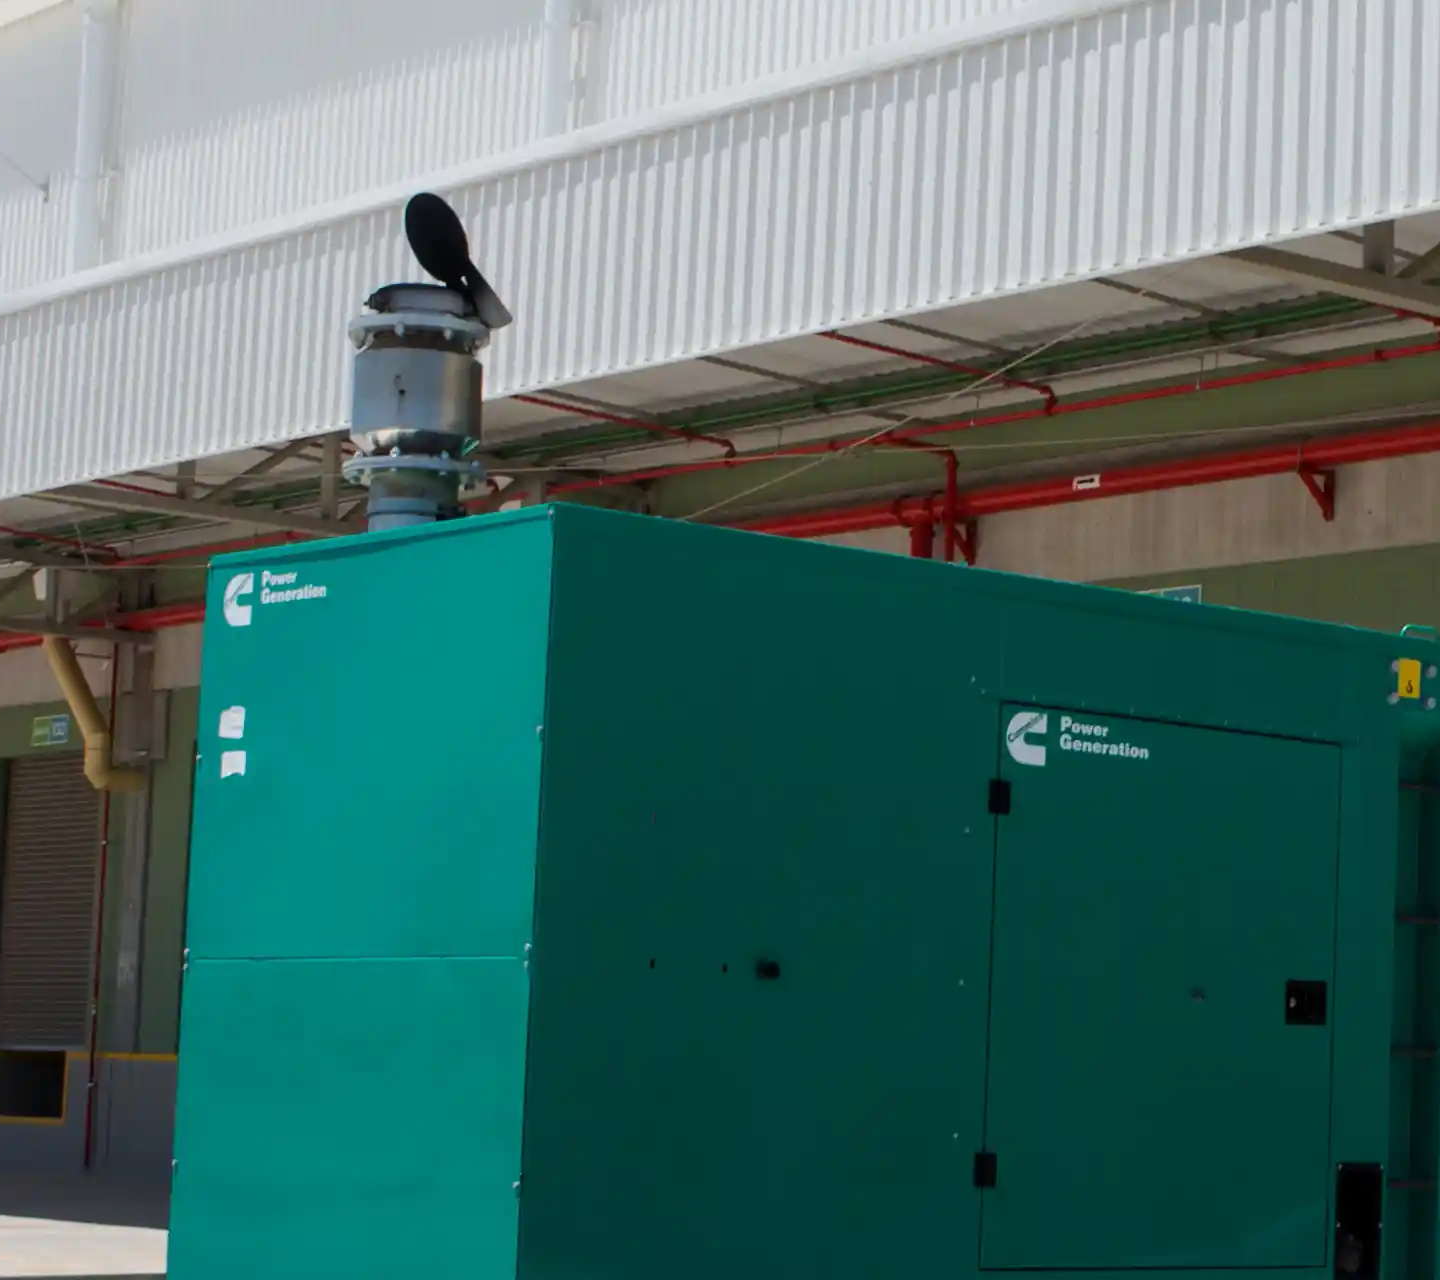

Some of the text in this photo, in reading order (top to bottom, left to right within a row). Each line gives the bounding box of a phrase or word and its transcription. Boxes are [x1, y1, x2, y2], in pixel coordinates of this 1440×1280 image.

[261, 569, 298, 587] Power
[261, 583, 327, 605] Generation
[1060, 716, 1109, 737] Power
[1059, 733, 1150, 760] Generation
